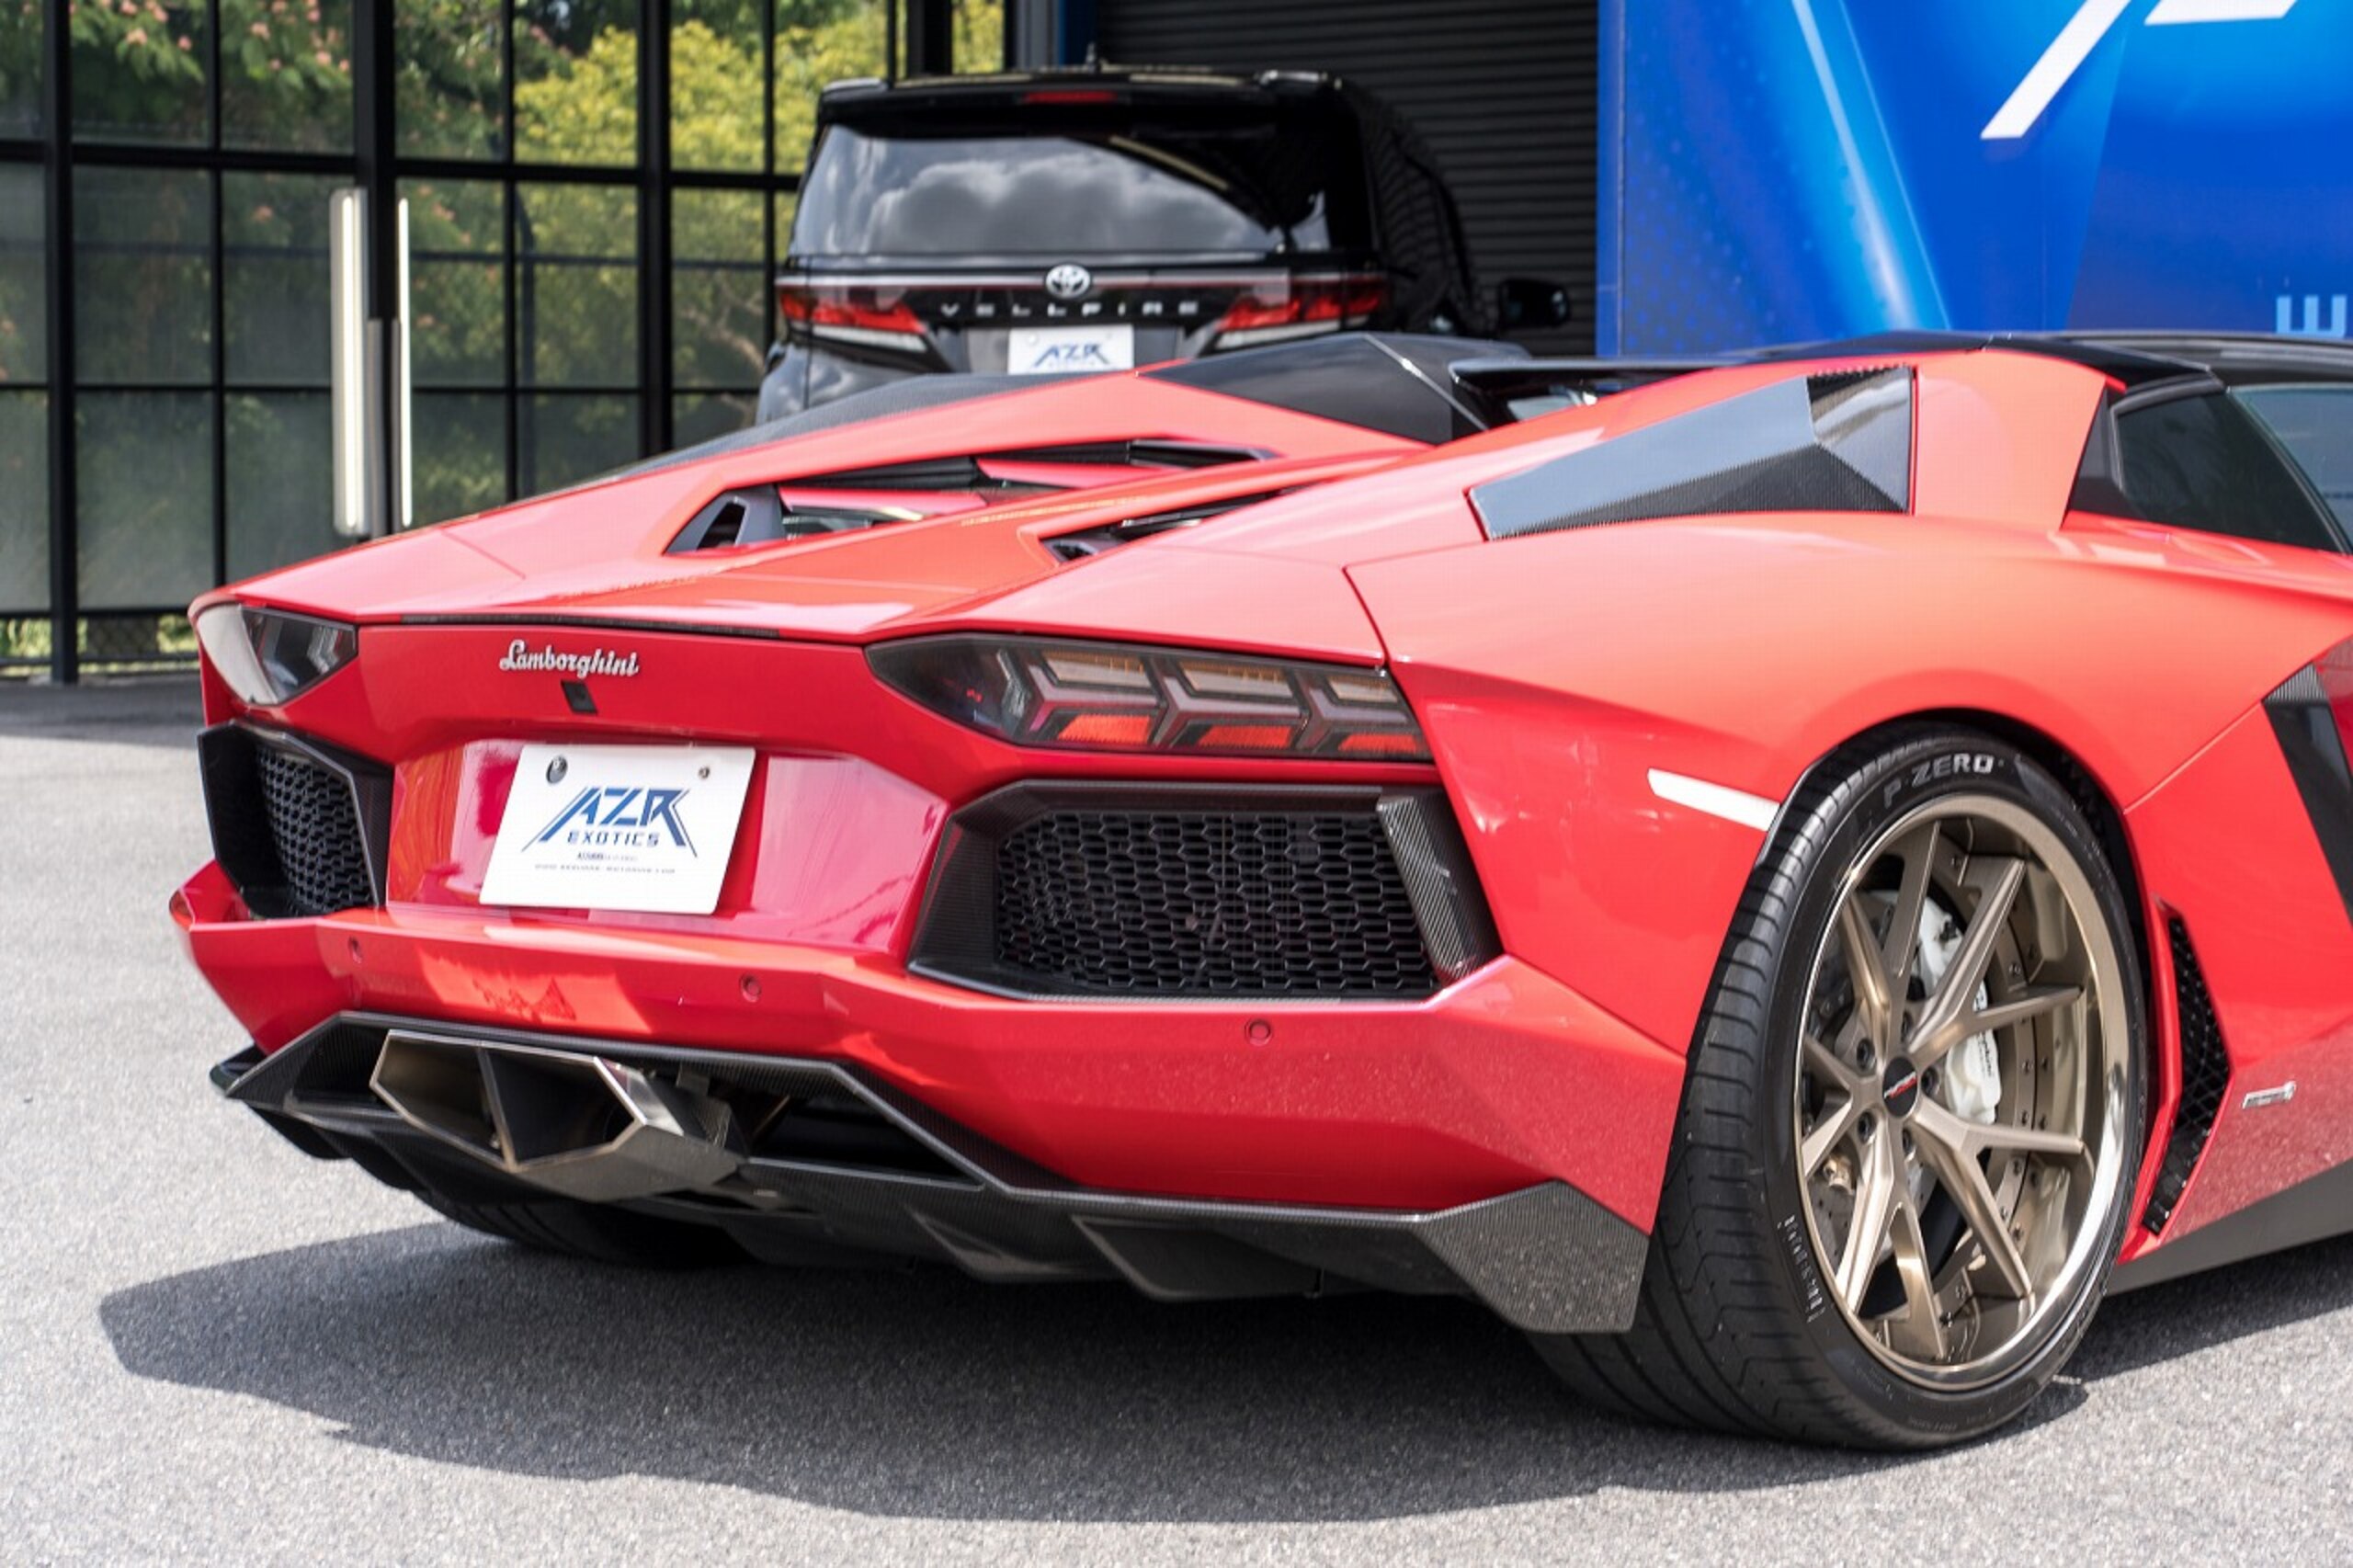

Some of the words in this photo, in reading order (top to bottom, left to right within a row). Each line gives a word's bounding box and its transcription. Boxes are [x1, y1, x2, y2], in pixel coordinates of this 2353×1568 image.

[941, 301, 1198, 316] VELLFIRE
[1034, 344, 1109, 367] AZR
[499, 639, 639, 678] Lamborghini
[1884, 778, 1902, 809] P
[1912, 753, 1995, 788] ZERO
[521, 786, 697, 858] AZR
[566, 830, 660, 847] EXOTICS
